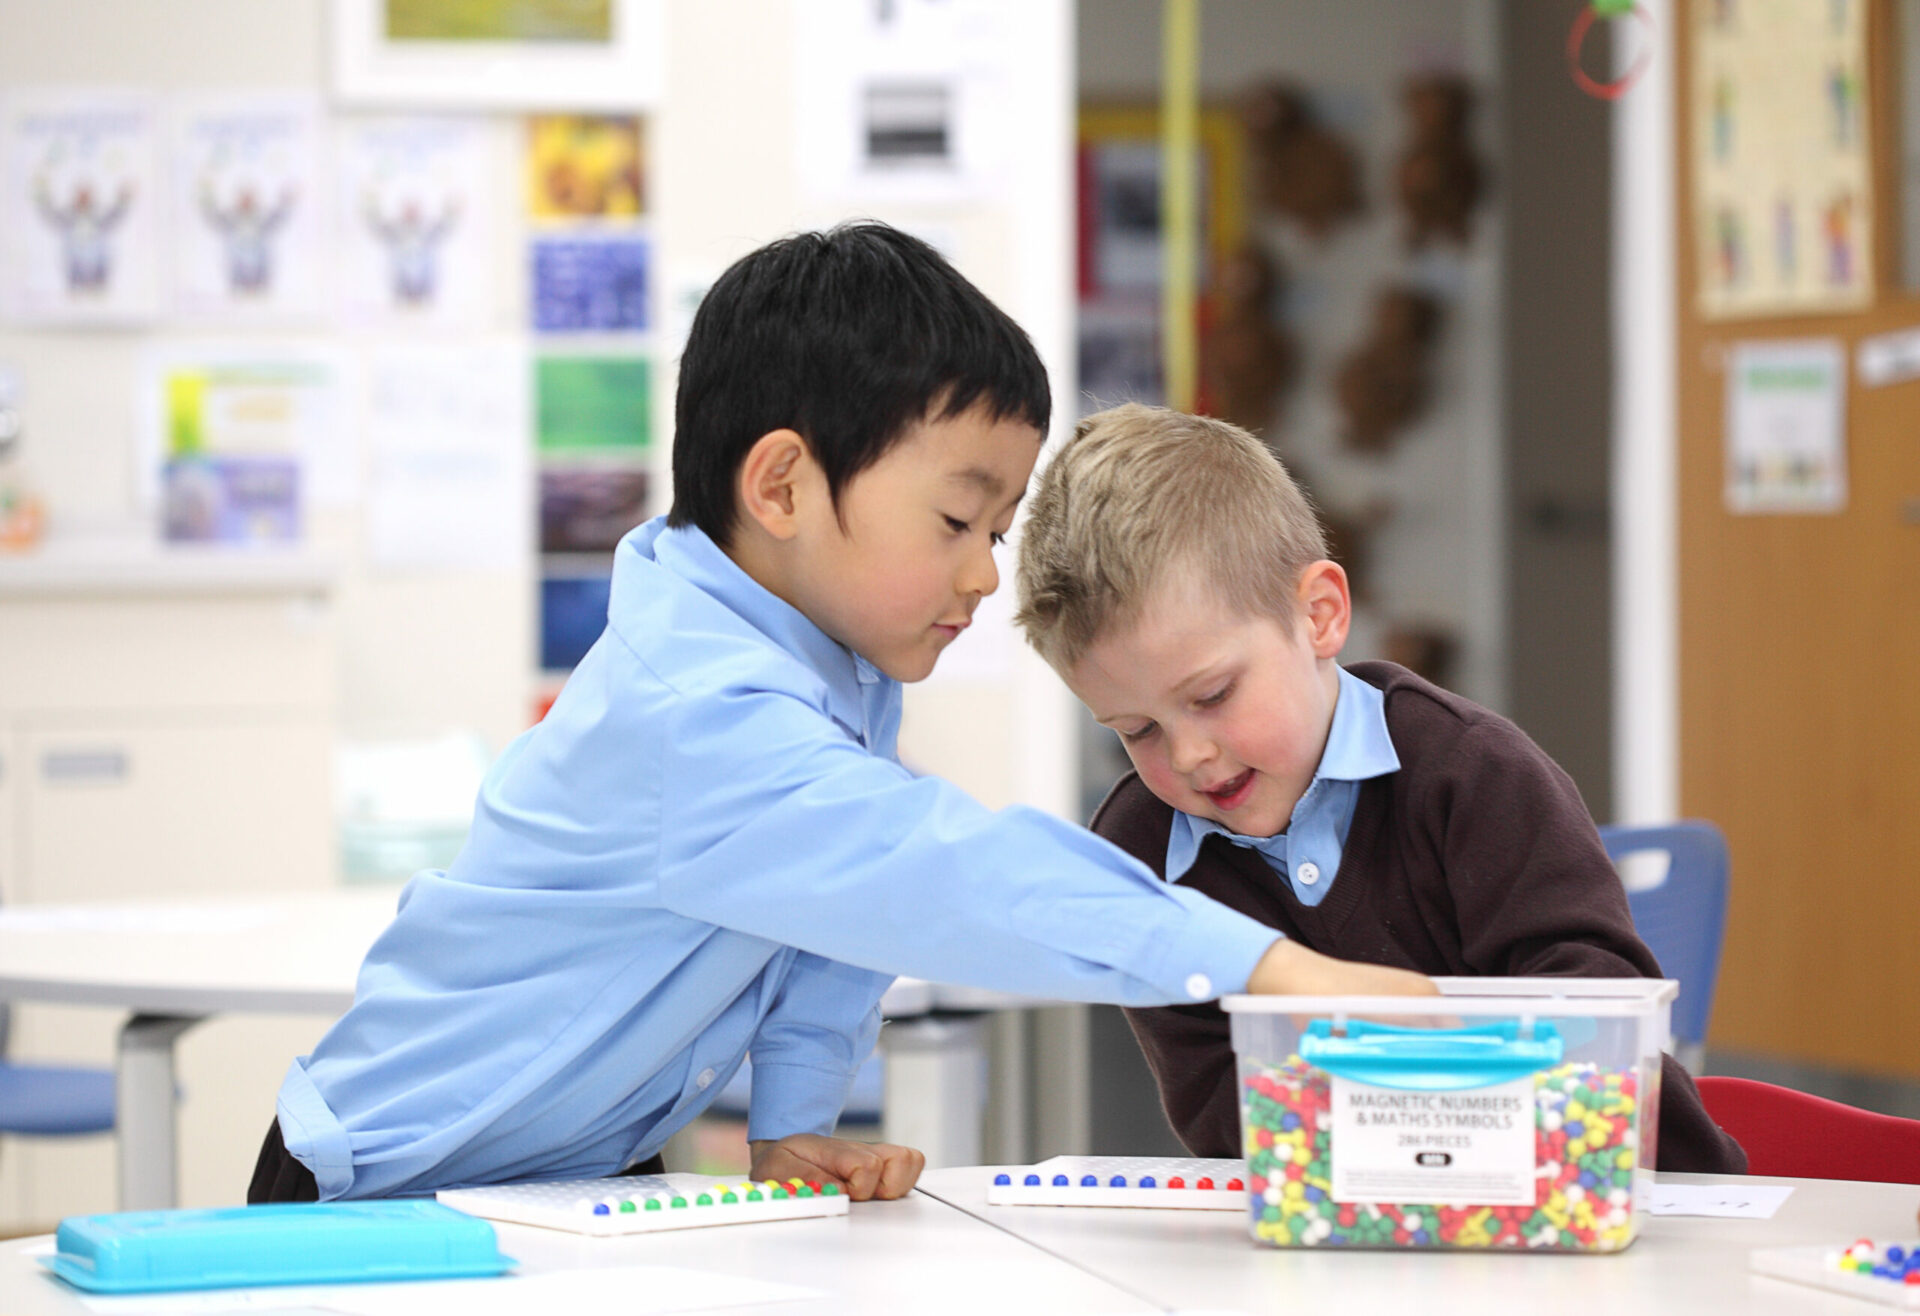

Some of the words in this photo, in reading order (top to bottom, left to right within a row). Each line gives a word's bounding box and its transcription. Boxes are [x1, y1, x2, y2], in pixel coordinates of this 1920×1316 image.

[1349, 1094, 1438, 1110] MAGNETIC
[1440, 1095, 1522, 1112] NUMBERS
[1356, 1112, 1367, 1126] &
[1372, 1112, 1430, 1128] MATHS
[1434, 1113, 1513, 1129] SYMBOLS
[1425, 1134, 1472, 1148] PIECES
